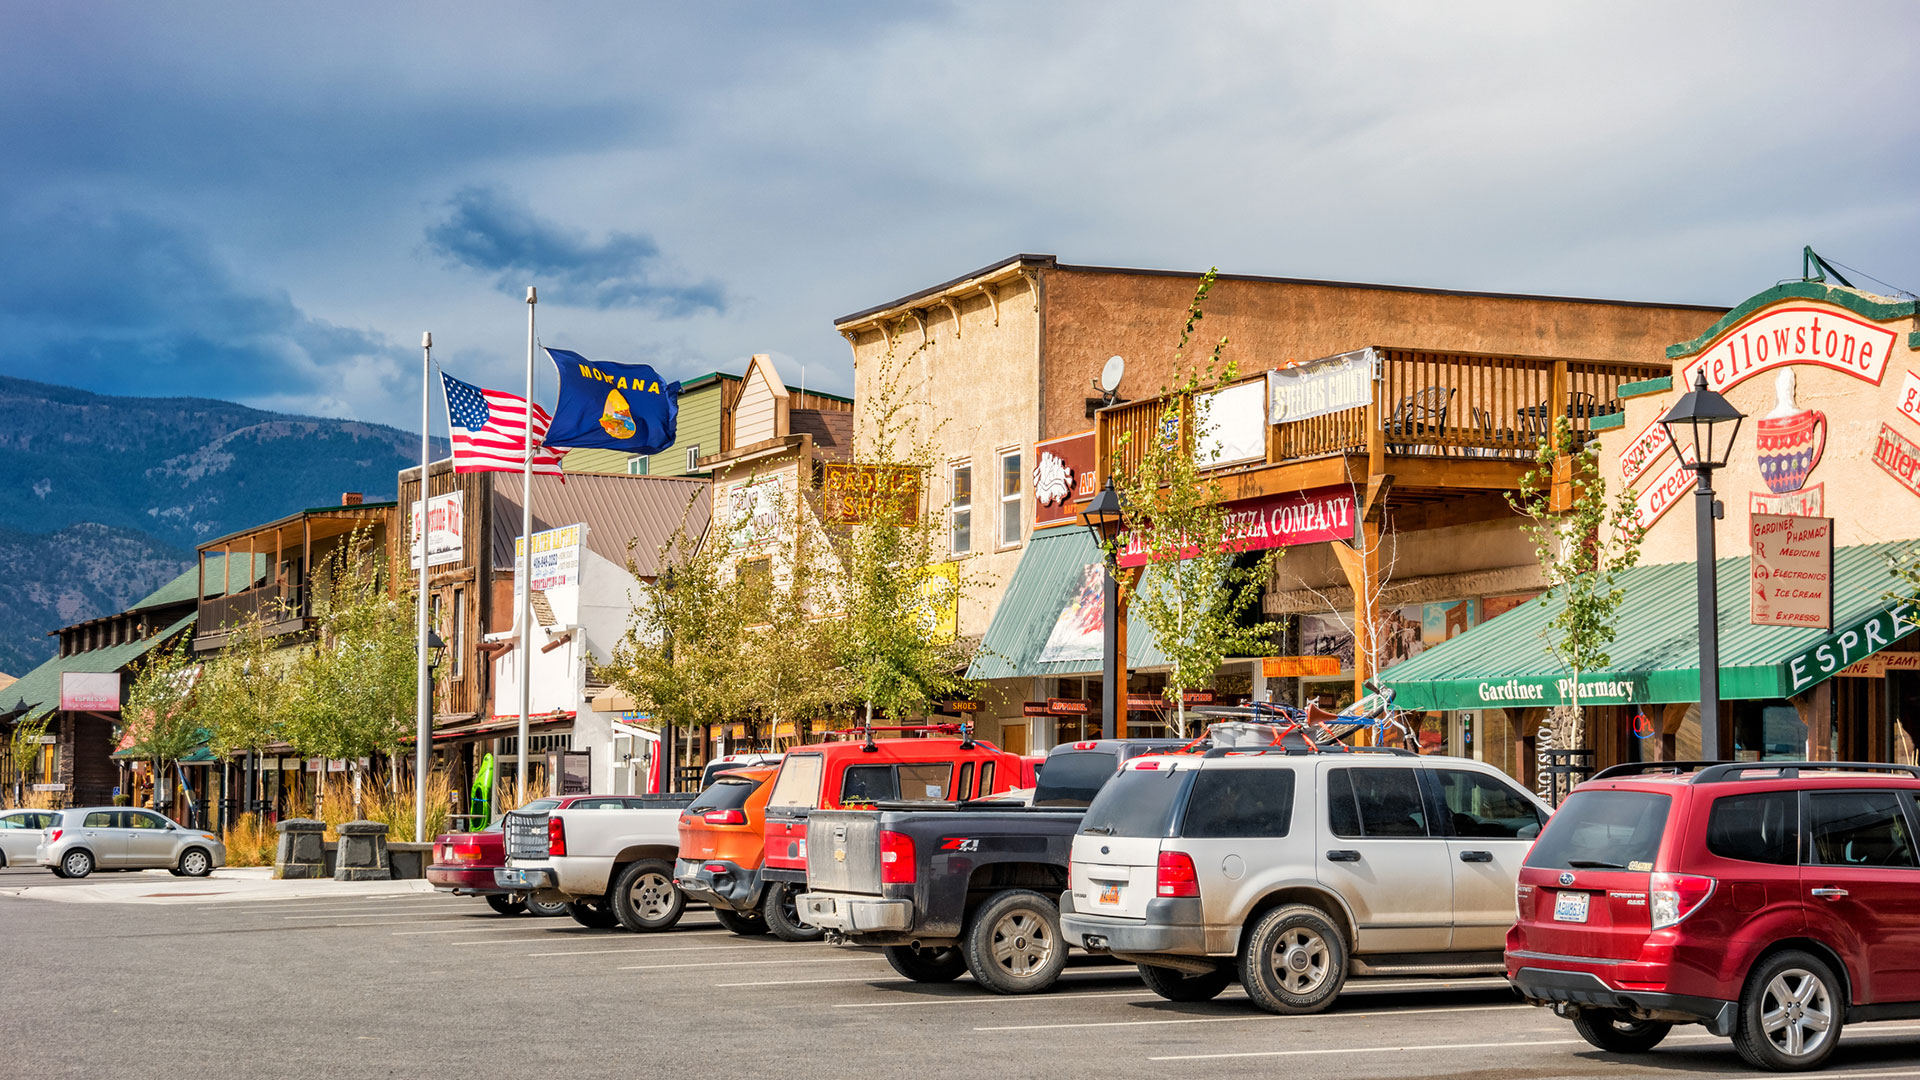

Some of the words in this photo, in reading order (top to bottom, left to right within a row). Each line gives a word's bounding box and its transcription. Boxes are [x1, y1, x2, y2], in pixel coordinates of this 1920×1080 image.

[1271, 496, 1350, 537] COMPANY
[1753, 518, 1794, 537] GARDINER
[1786, 524, 1828, 545] PHARMACY
[1779, 547, 1821, 558] MEDICINE
[1773, 568, 1827, 581] ELECTRONICS
[1774, 588, 1790, 598] ICE
[1791, 588, 1822, 599] CREAM
[1775, 610, 1820, 622] EXPRESSO
[1478, 679, 1544, 702] Gardiner
[1558, 677, 1634, 703] Pharmacy
[952, 702, 977, 711] SHOES
[1051, 702, 1088, 712] APPAREL
